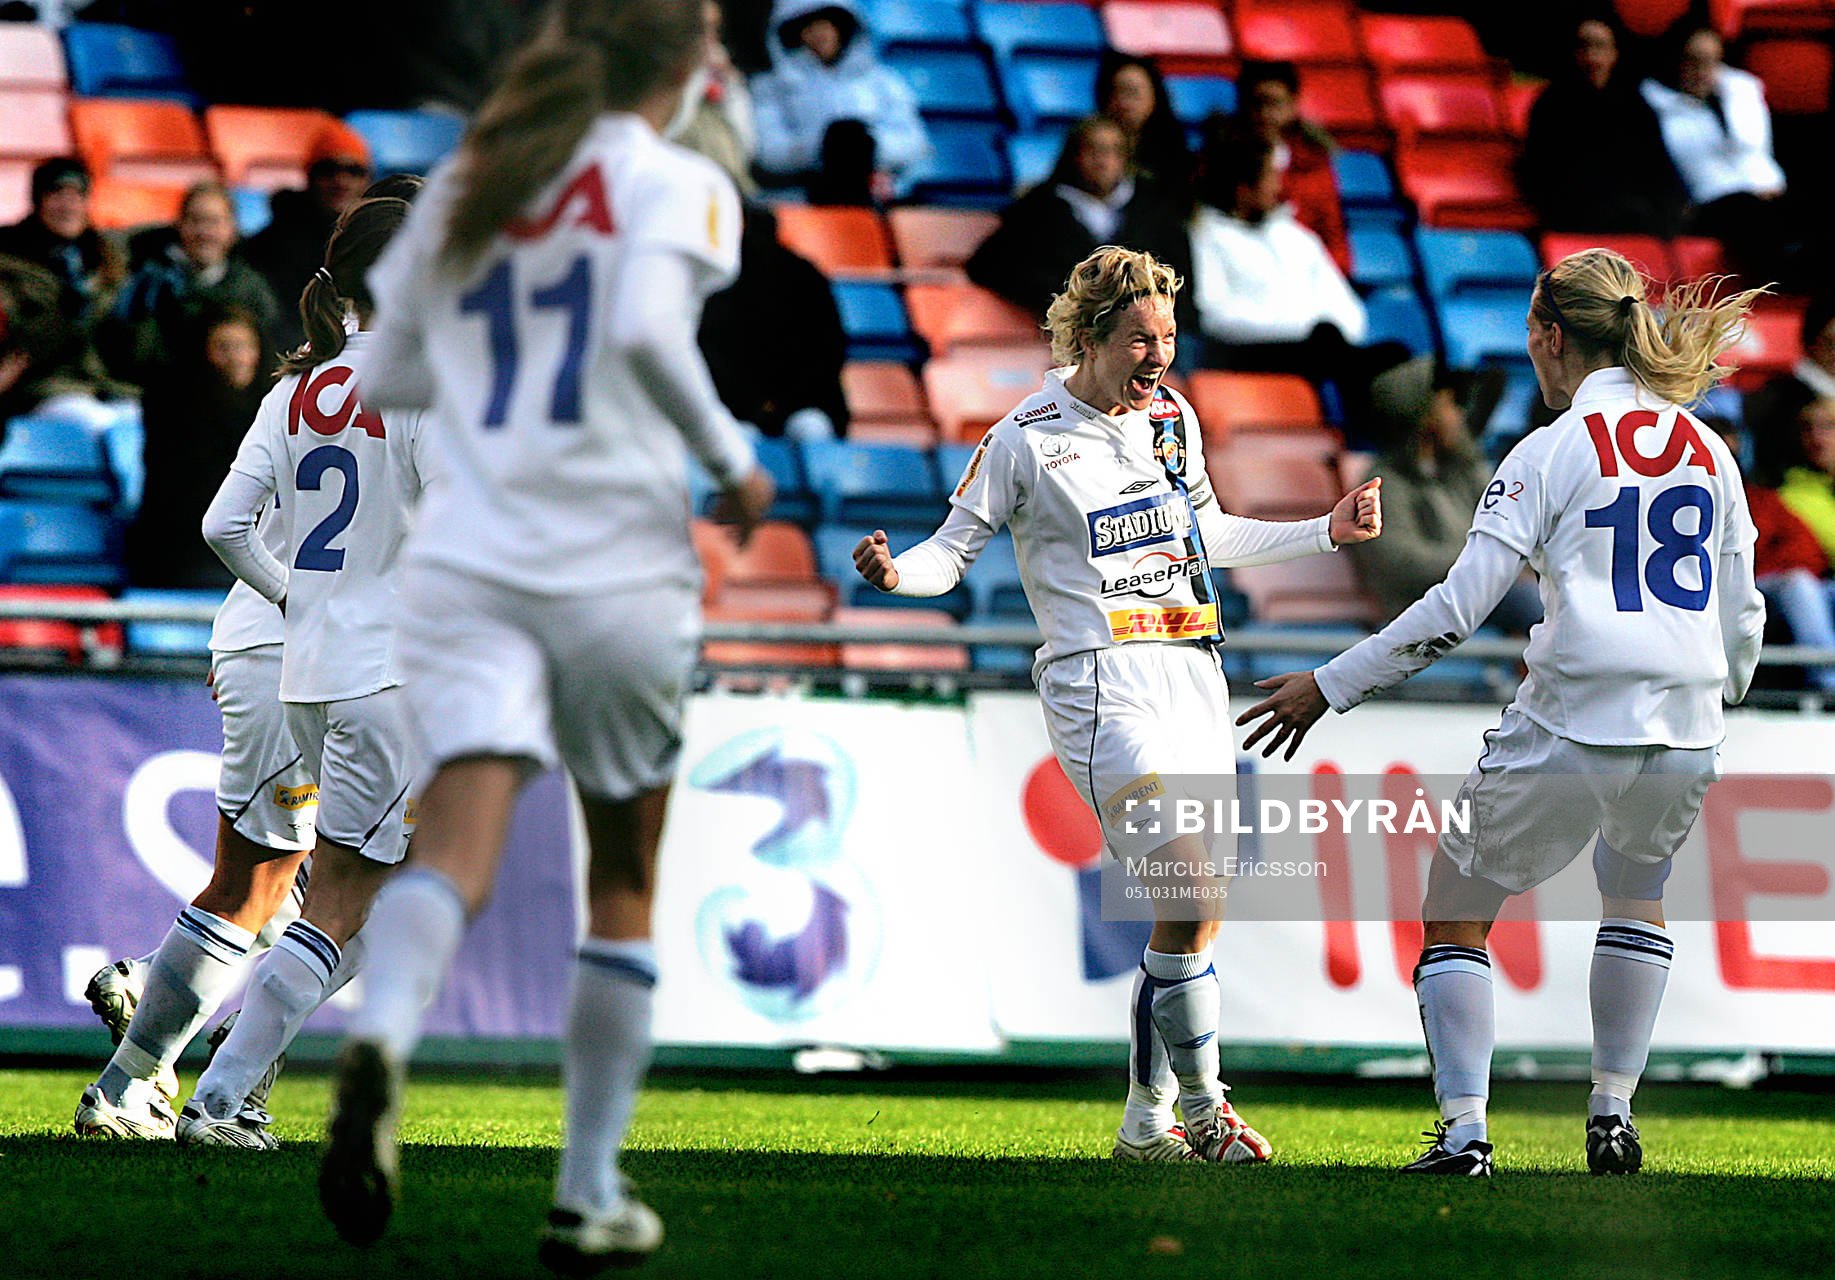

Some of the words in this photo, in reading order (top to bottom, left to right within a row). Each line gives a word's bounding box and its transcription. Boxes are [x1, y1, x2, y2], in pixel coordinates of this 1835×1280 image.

[458, 251, 592, 430] 11
[1013, 401, 1058, 422] Canon
[1044, 452, 1081, 471] TOYOTA
[1583, 410, 1717, 478] ICA
[294, 445, 359, 572] 2
[1094, 499, 1192, 550] STADIUM
[1585, 484, 1713, 612] 18
[1128, 611, 1206, 634] DHL
